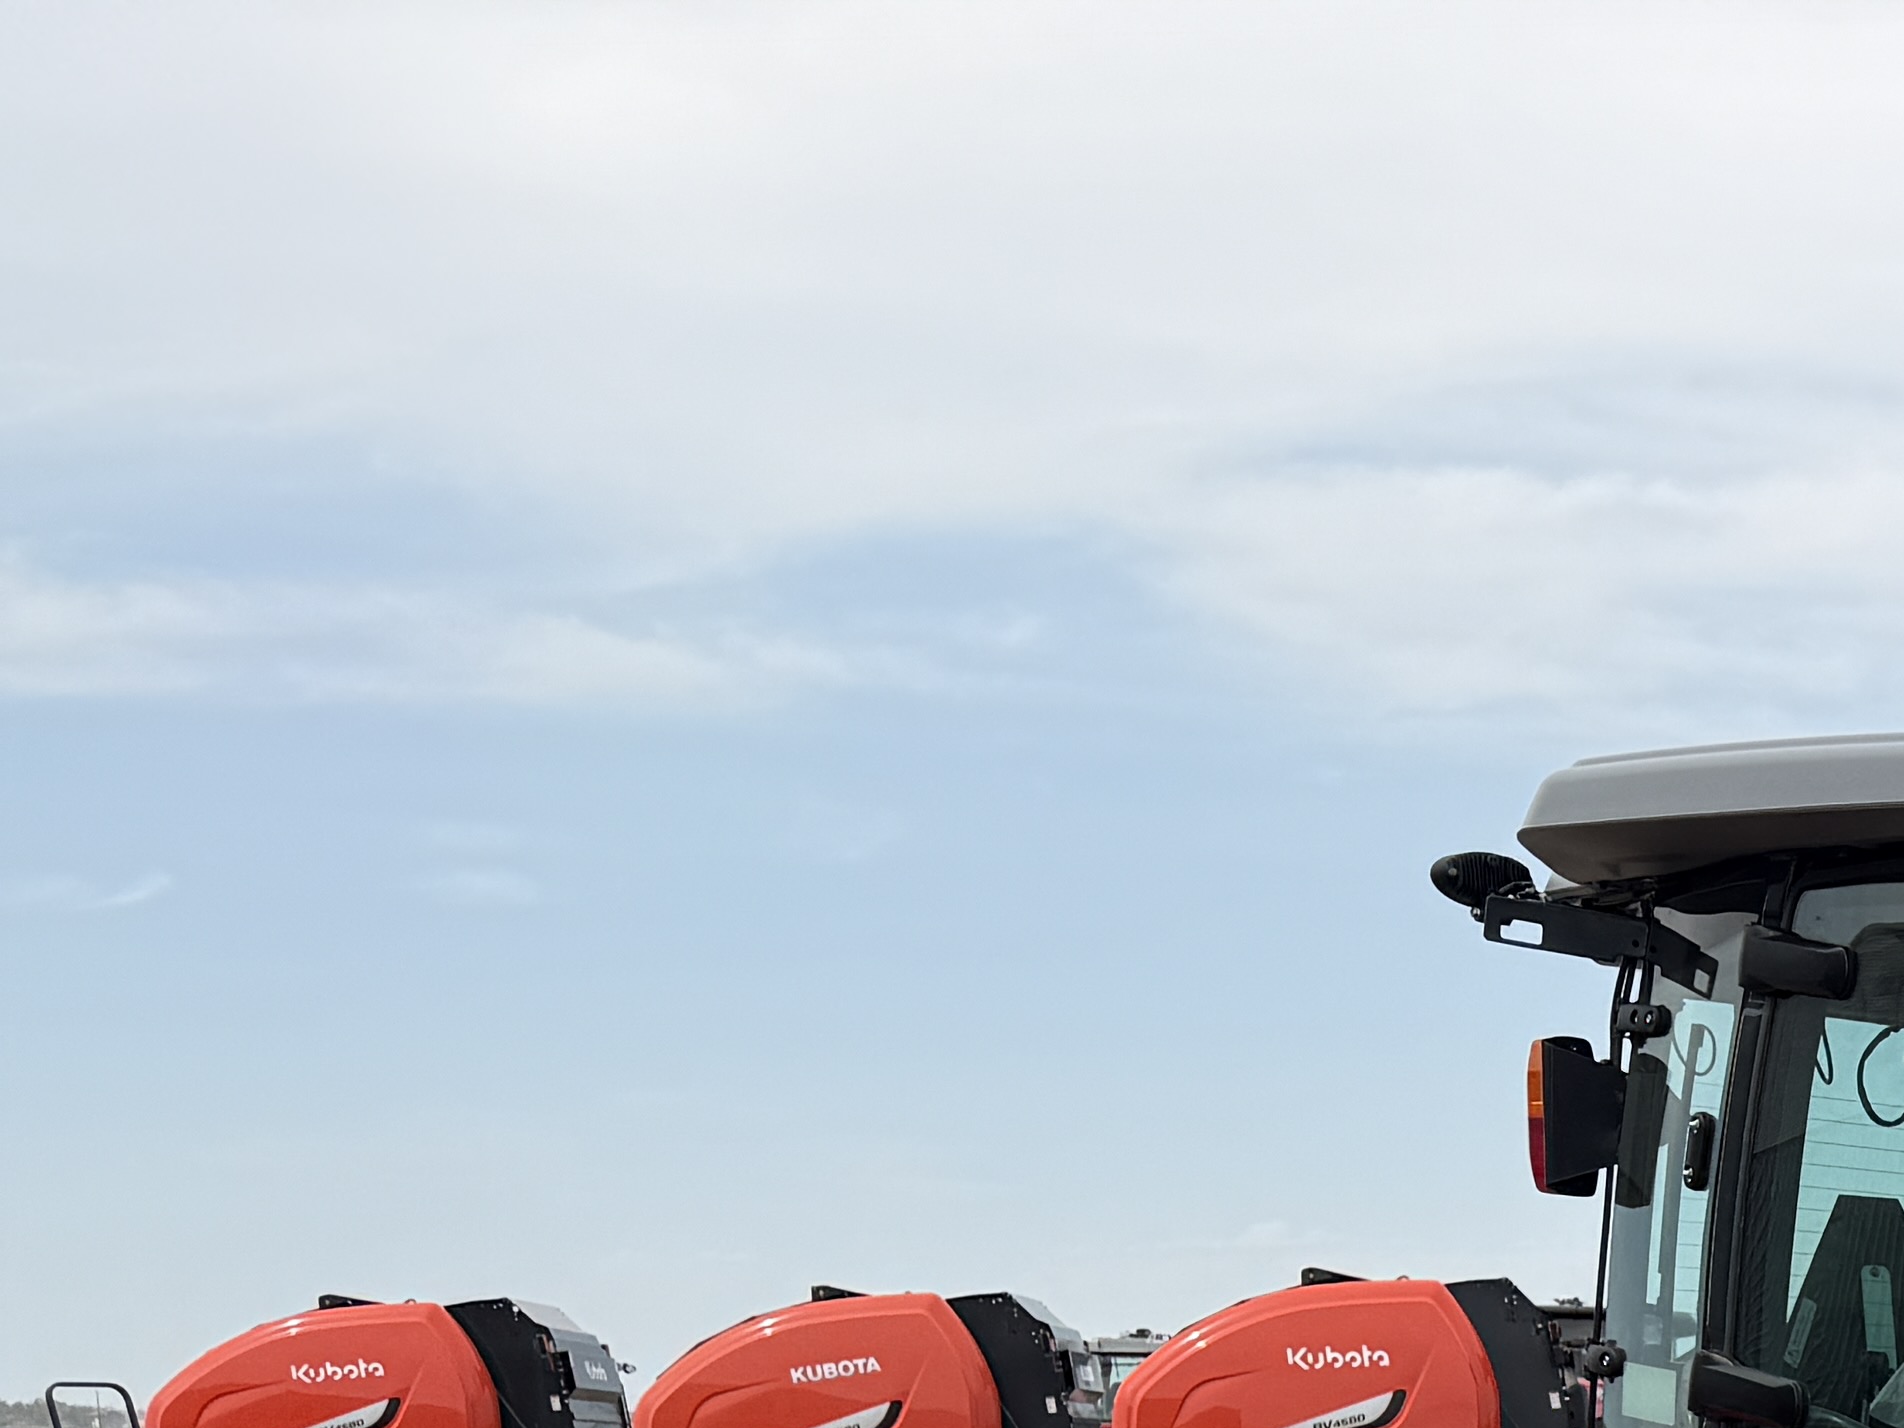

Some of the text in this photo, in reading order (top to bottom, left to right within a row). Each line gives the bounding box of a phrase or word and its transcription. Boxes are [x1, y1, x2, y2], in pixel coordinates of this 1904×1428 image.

[290, 1358, 385, 1384] Kubota
[790, 1356, 882, 1384] KUBOTA
[1286, 1344, 1391, 1371] Kubota
